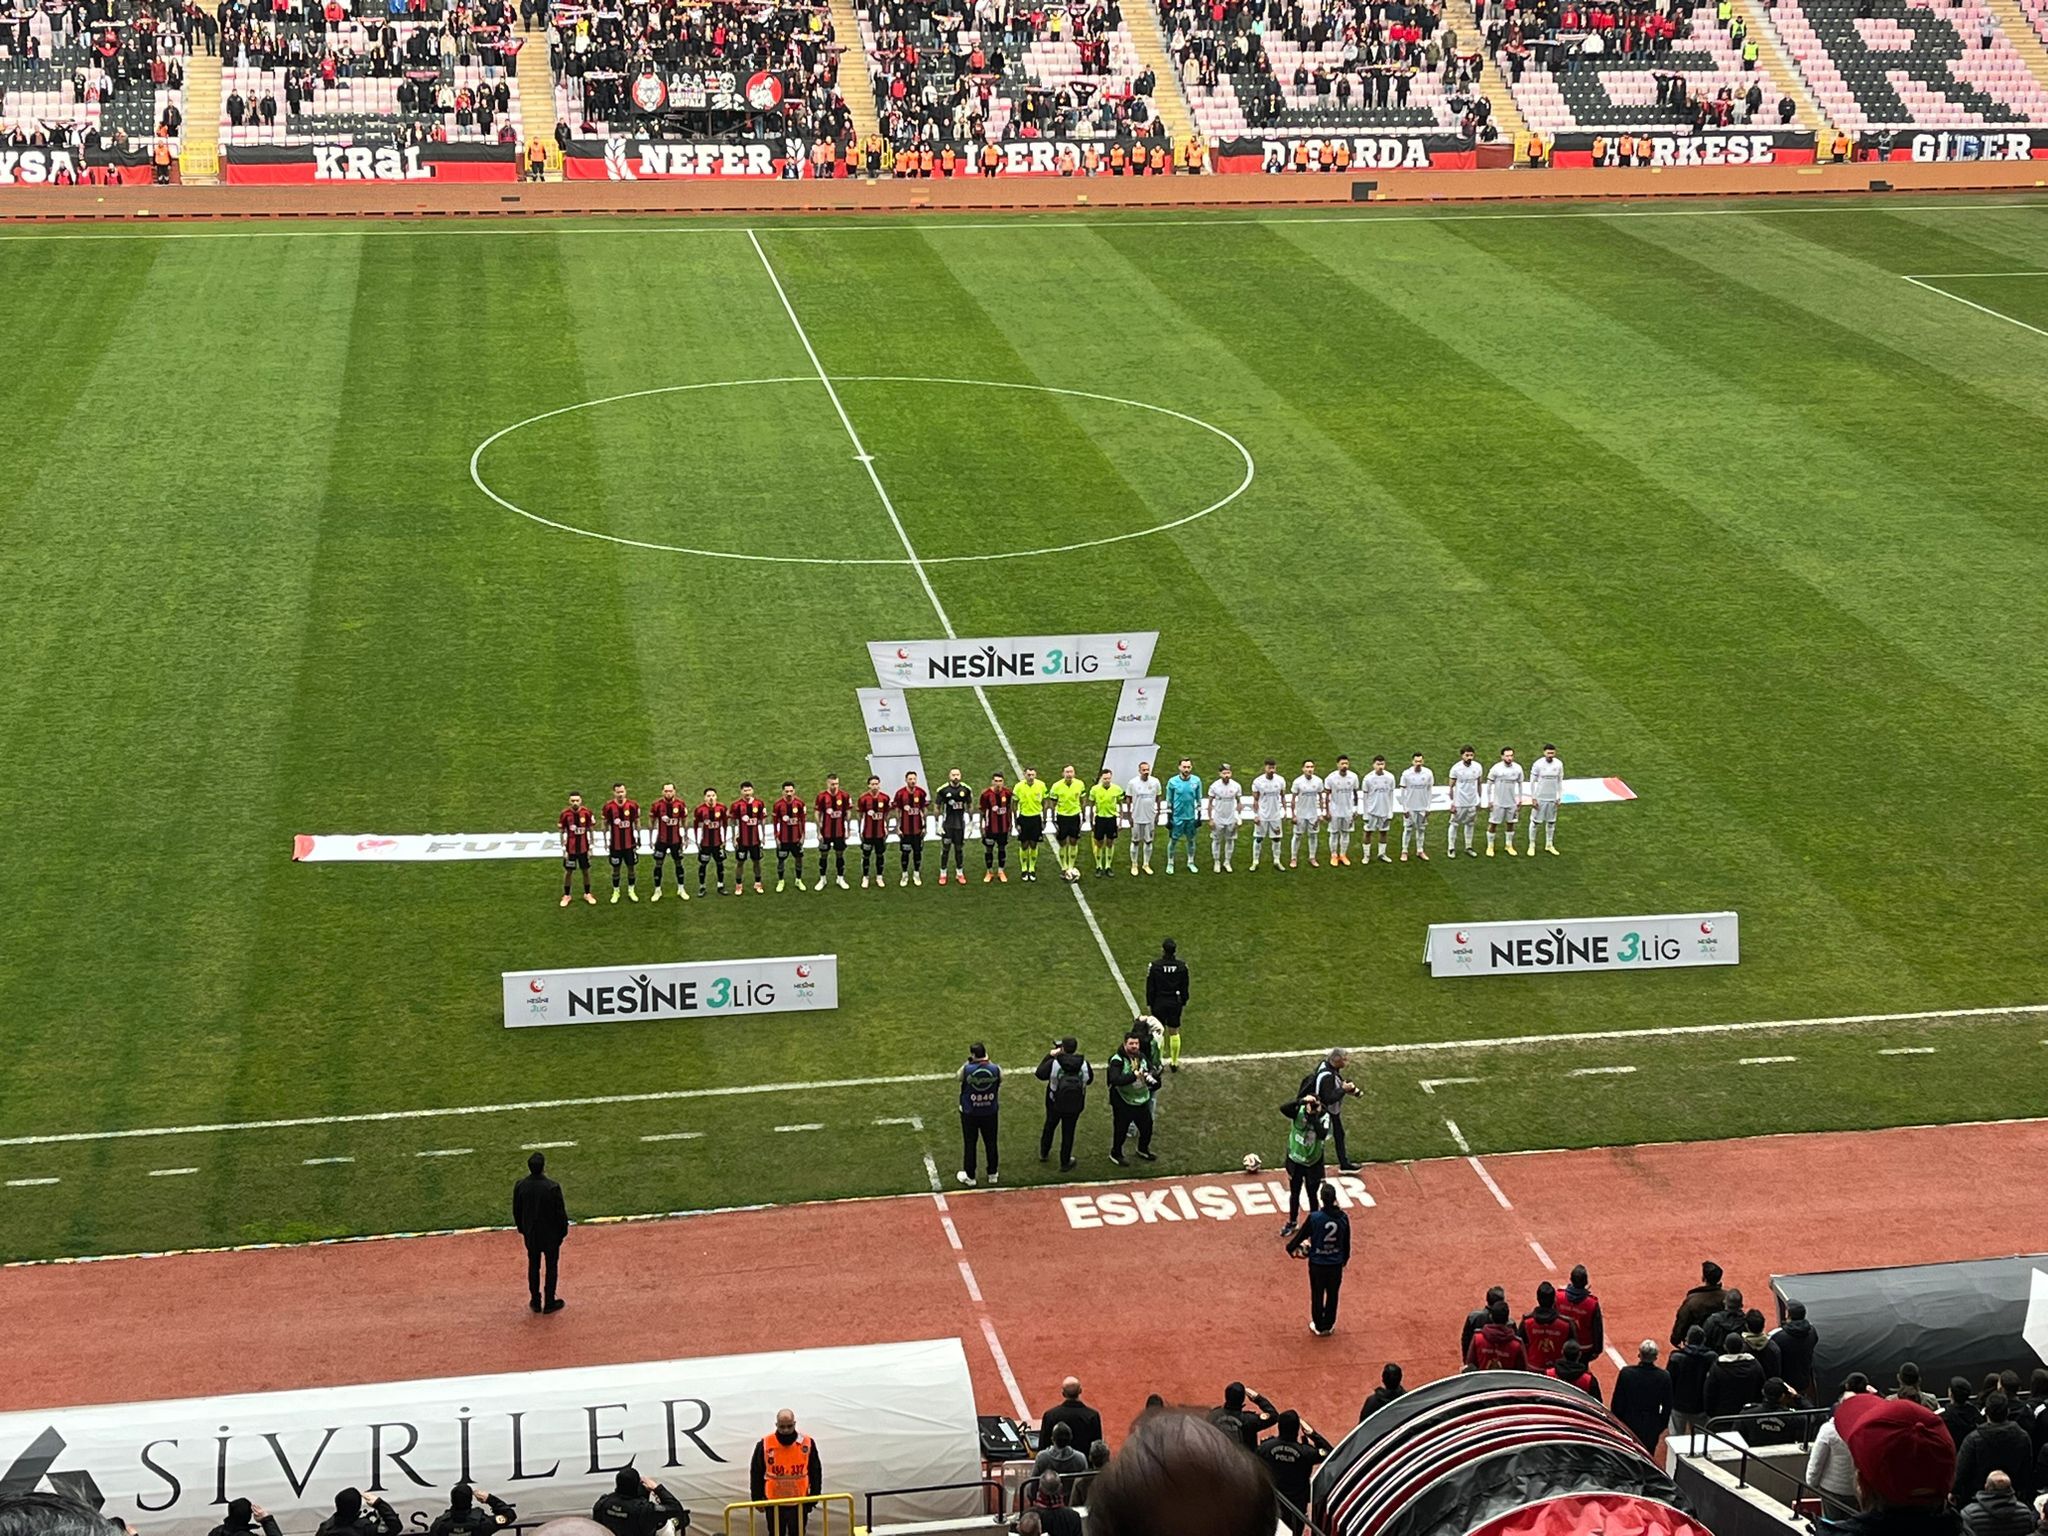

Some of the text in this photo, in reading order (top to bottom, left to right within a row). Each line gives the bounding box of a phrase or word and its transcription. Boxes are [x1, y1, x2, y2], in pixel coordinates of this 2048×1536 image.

[638, 144, 774, 175] NEFER
[1490, 928, 1609, 967] NESİNE
[568, 973, 698, 1017] NESİNE
[1323, 1221, 1338, 1242] 2
[136, 1398, 729, 1512] SİVRİLER
